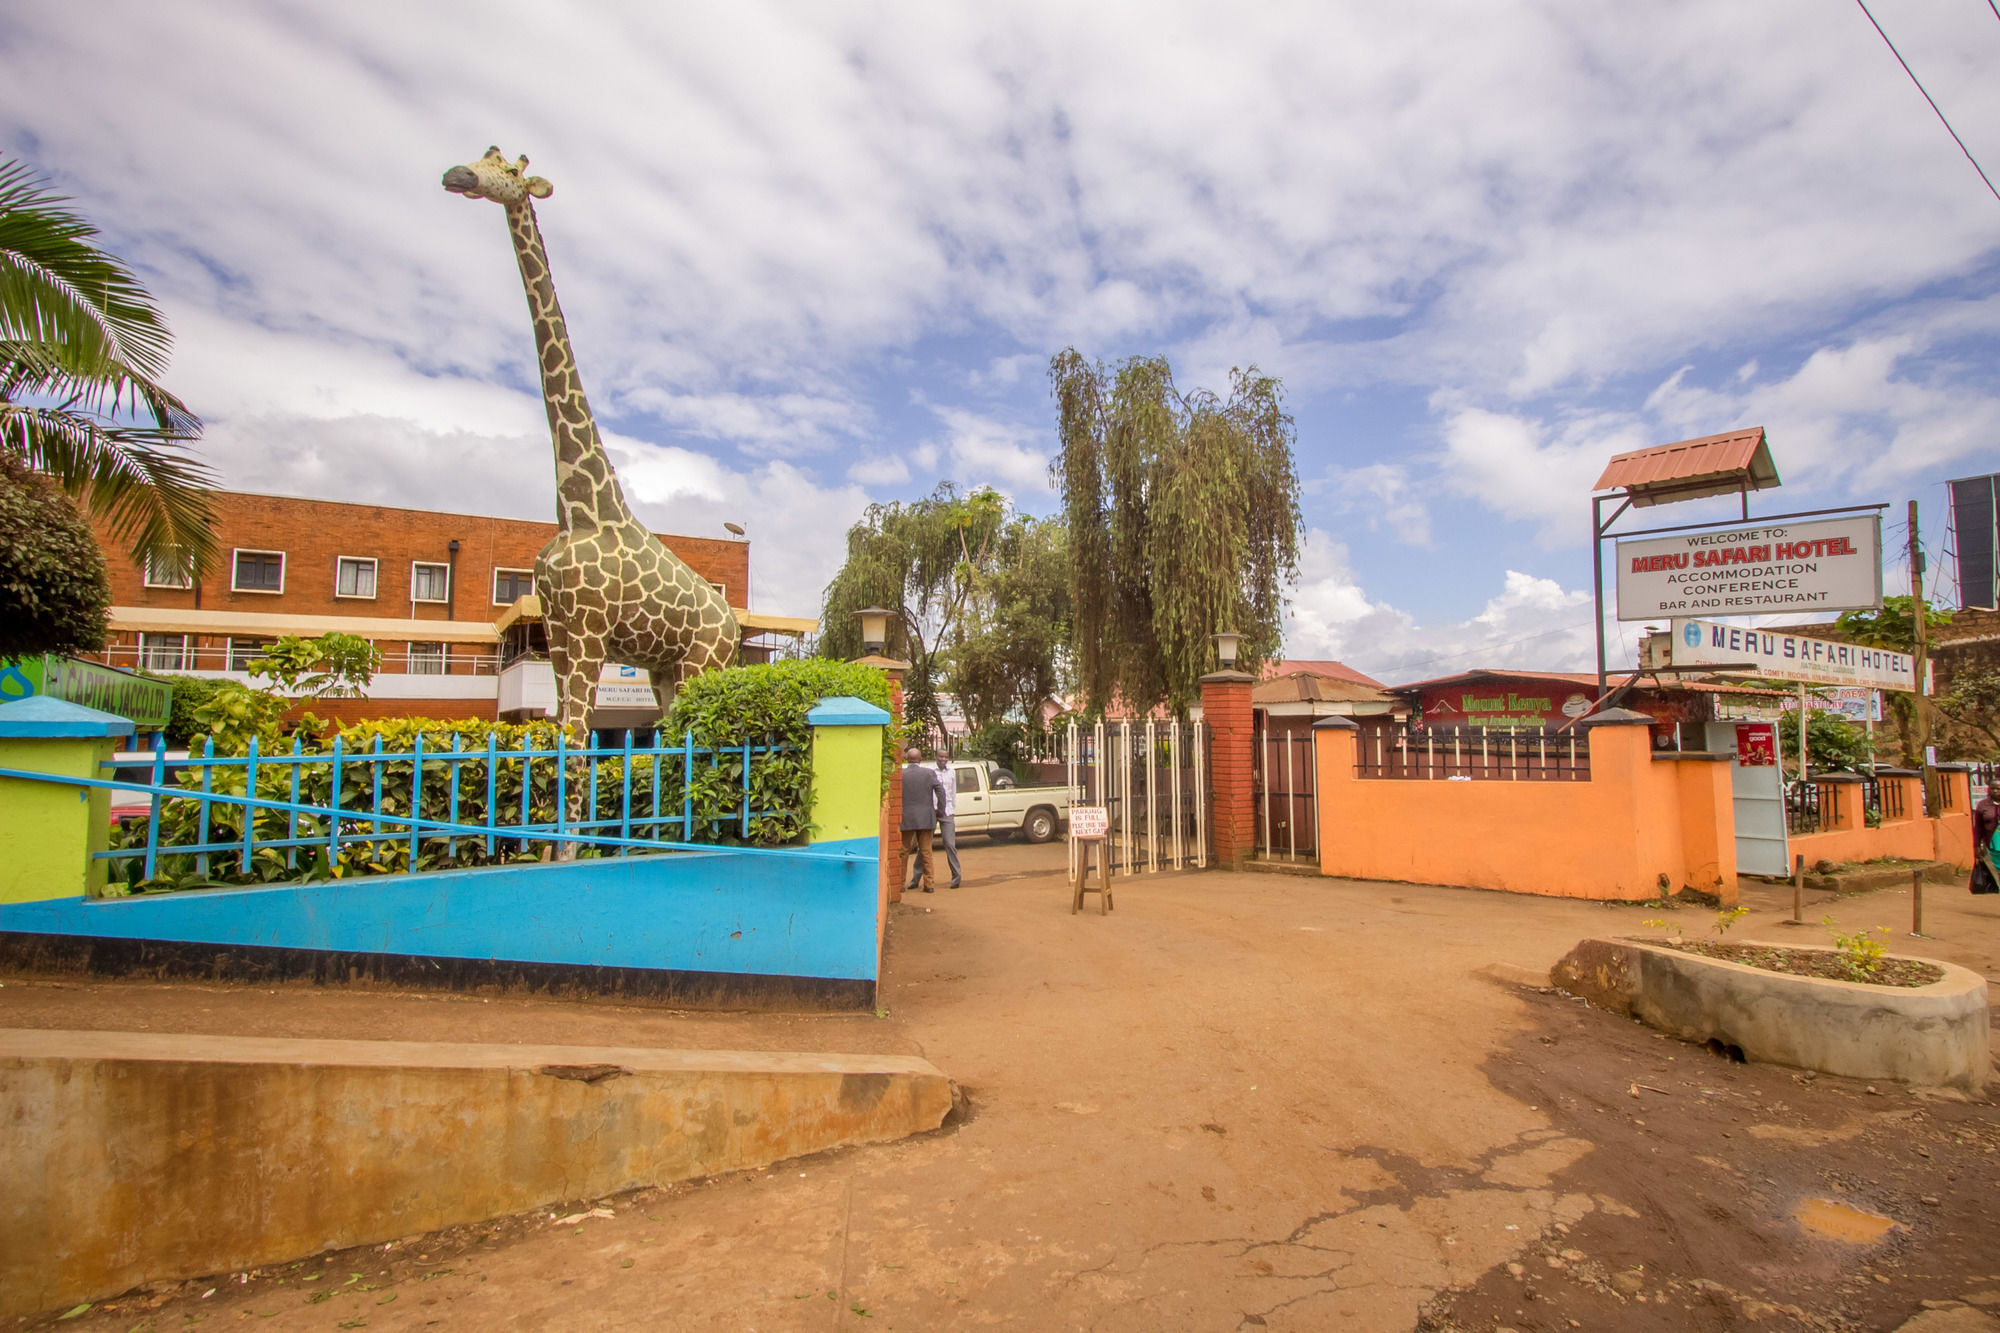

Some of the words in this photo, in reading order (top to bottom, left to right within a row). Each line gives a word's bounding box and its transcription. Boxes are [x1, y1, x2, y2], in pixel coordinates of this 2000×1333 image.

[1687, 531, 1760, 547] WELCOME
[1763, 529, 1788, 539] TO:
[1631, 552, 1689, 573] MERU
[1693, 544, 1771, 568] SAFARI
[1775, 537, 1857, 561] HOTEL
[1667, 563, 1817, 584] ACCOMMODATION
[1683, 578, 1799, 596] CONFERENCE
[1659, 601, 1687, 610] BAR
[1691, 598, 1721, 608] AND
[1725, 591, 1828, 606] RESTAURANT
[1712, 625, 1774, 656] MERU
[1783, 638, 1855, 666] SAFARI
[1861, 650, 1908, 673] HOTEL
[65, 667, 116, 715] CAPITAL
[119, 682, 149, 718] SACCO
[149, 687, 164, 719] LTD
[1462, 694, 1505, 712] Mount
[1508, 693, 1552, 714] Kenya
